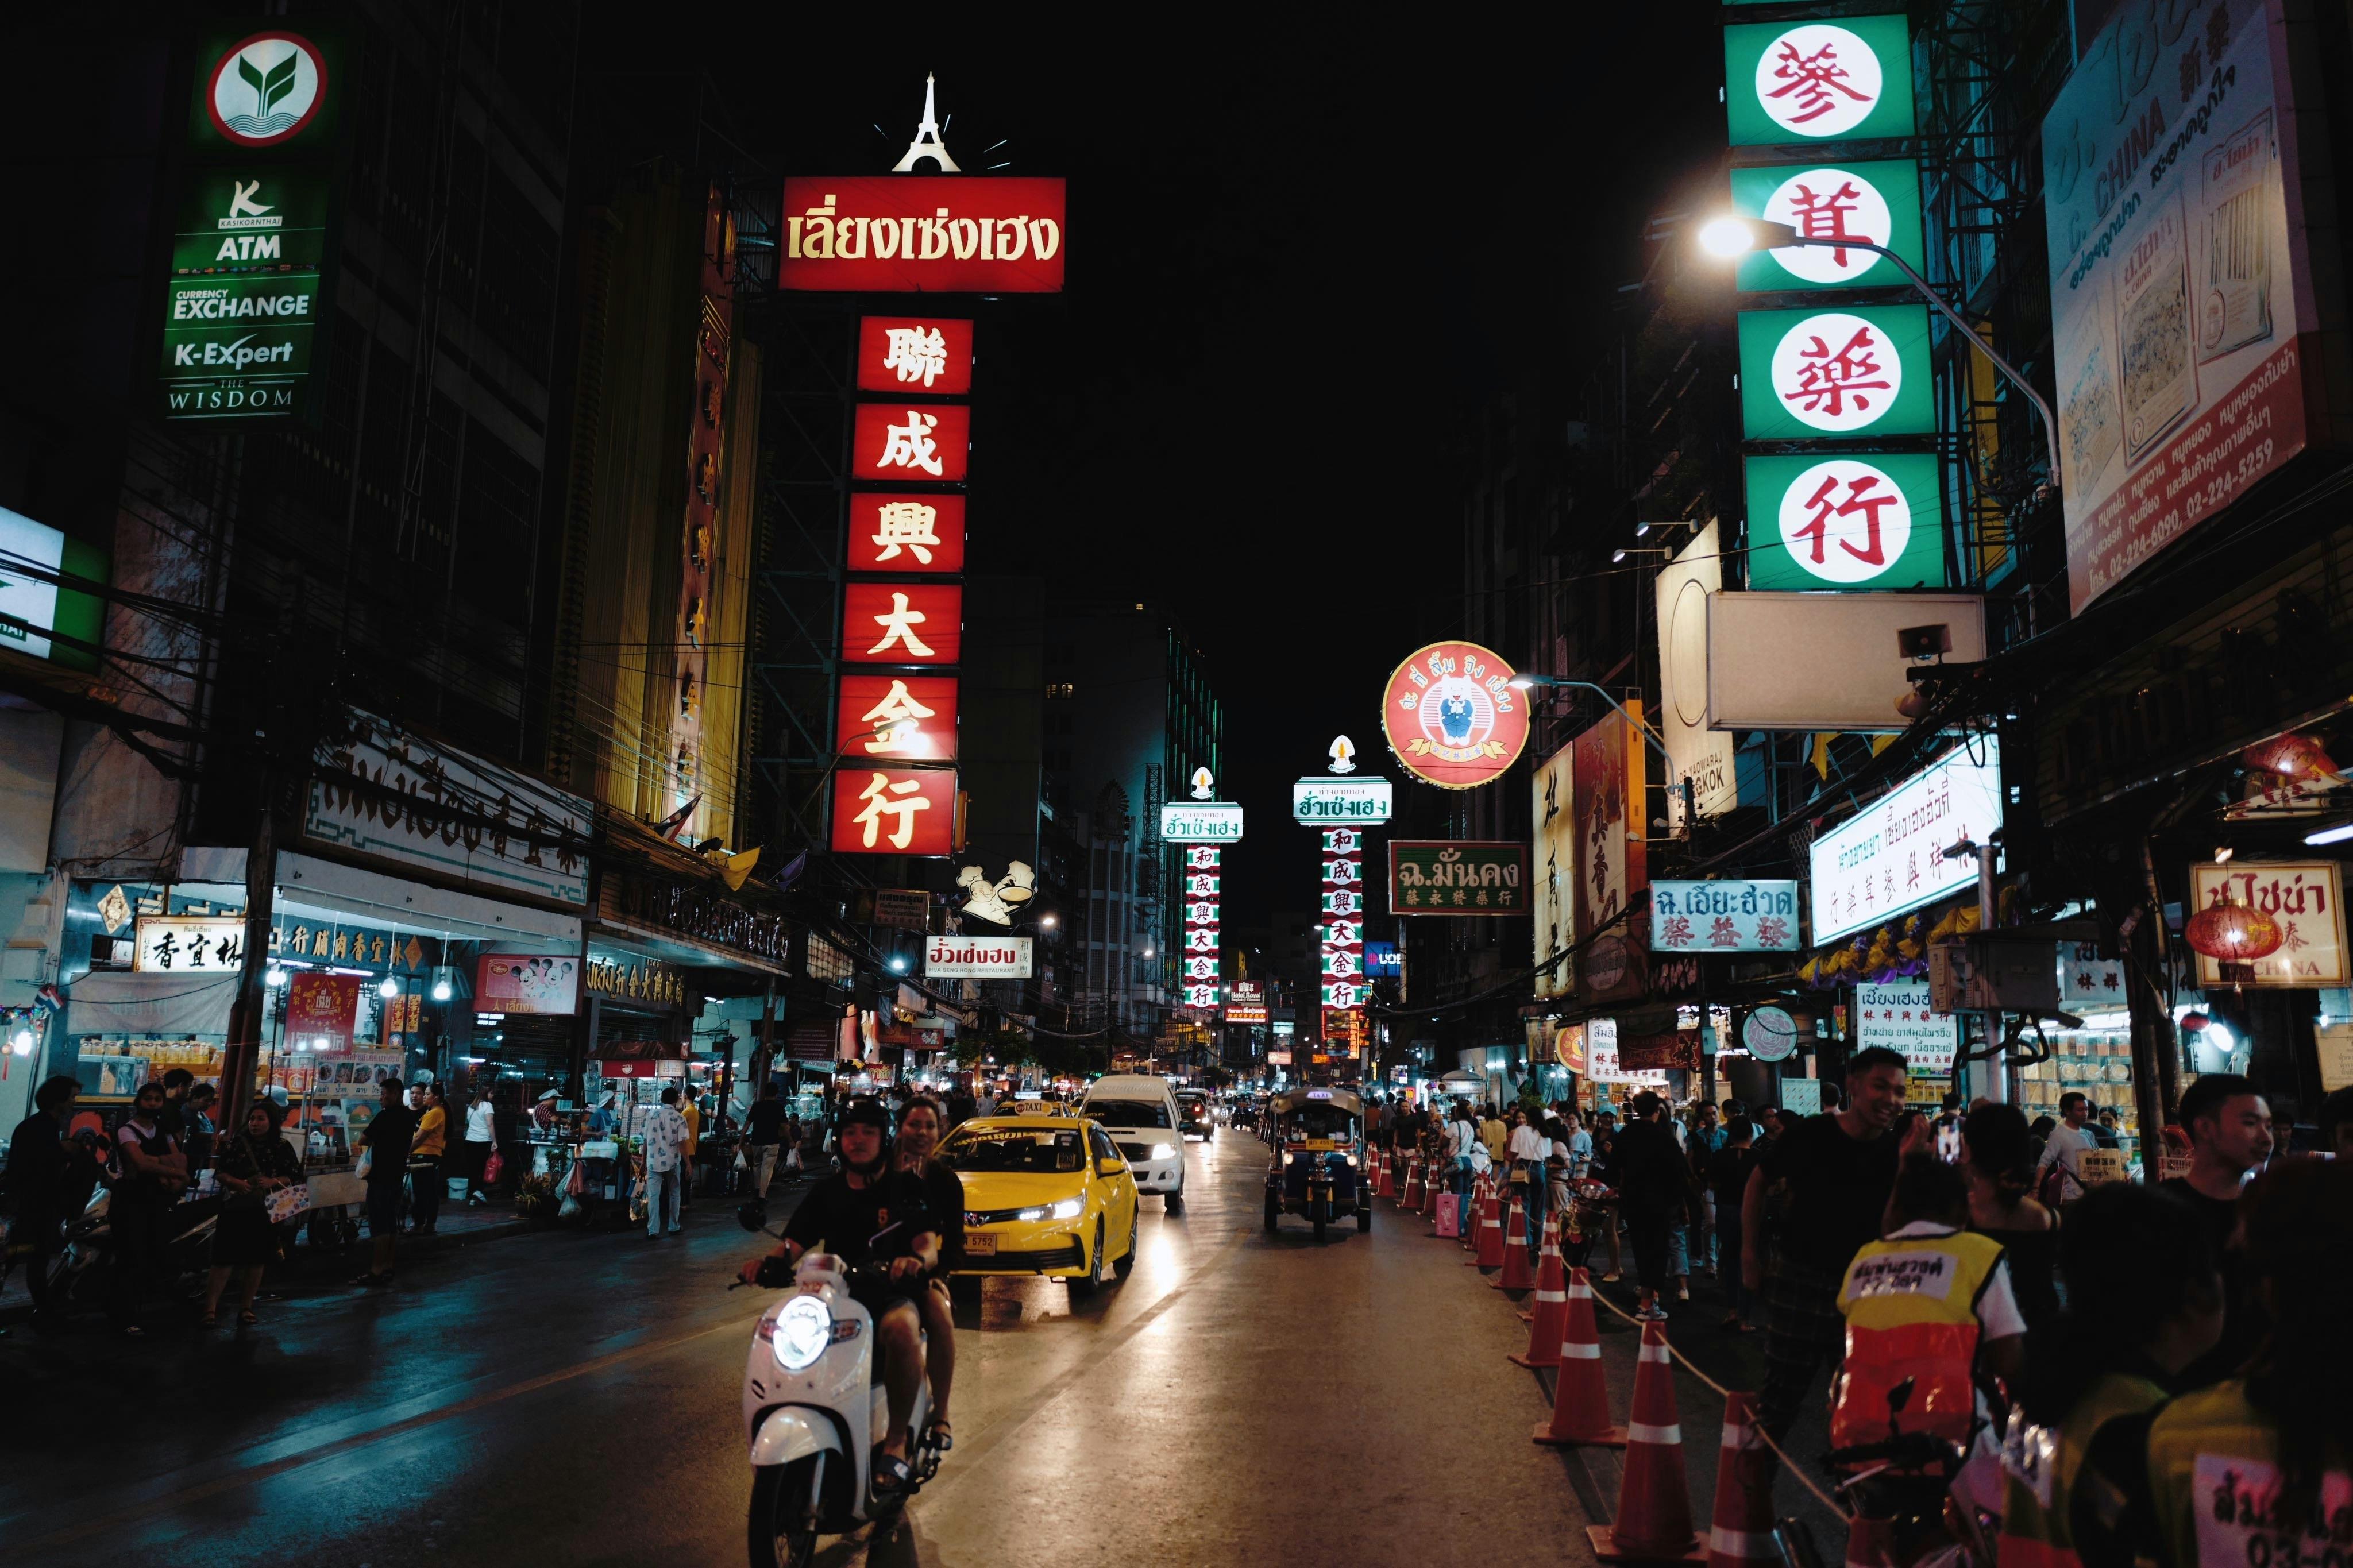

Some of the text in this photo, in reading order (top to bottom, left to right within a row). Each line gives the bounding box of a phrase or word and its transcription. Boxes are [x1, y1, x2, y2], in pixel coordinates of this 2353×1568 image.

[2094, 96, 2165, 217] CHINA
[220, 218, 281, 228] KASIKORNTHAI
[788, 194, 1059, 260] เลี่ยงเซ่งเฮง
[216, 235, 280, 261] ATM
[173, 295, 309, 319] EXCHANGE
[176, 289, 229, 299] CURRENCY
[175, 334, 293, 369] K-Expert
[219, 379, 244, 388] THE
[169, 390, 292, 409] WISDOM
[2098, 495, 2126, 530] หมูแผ่น
[2131, 458, 2165, 500] หมูหวาน
[2171, 422, 2212, 465] หมูหยอง
[2220, 350, 2296, 428] หมูหยองต้มยำ
[2090, 565, 2107, 594] โทร.
[2186, 439, 2273, 517] 02-224-5259
[852, 326, 947, 849] 聯成興大金行
[1689, 751, 1722, 776] YAOWARAJ
[1679, 766, 1724, 808] BGKOK
[1299, 790, 1386, 816] ฮั่วเซ่งเฮง
[1167, 814, 1239, 835] ฮั่วเซ่งเฮง
[1838, 833, 1880, 872] ห้างขายยา
[1399, 848, 1518, 887] ฉ.มั่นคง
[1406, 889, 1513, 905] 蔡永發藥行
[1193, 849, 1212, 1005] 和成興大金行
[1331, 831, 1352, 1005] 和成興大金行
[1659, 916, 1792, 948] 蔡益發
[930, 938, 1015, 964] ฮั่วเซ่งฮง
[1863, 987, 1930, 1006] เซี้ยงเฮงฮั
[1863, 1027, 1951, 1040] จำหน่าย ยาสมุนไพรจีน
[1887, 1041, 1910, 1052] รังนก
[973, 1237, 992, 1246] 5752
